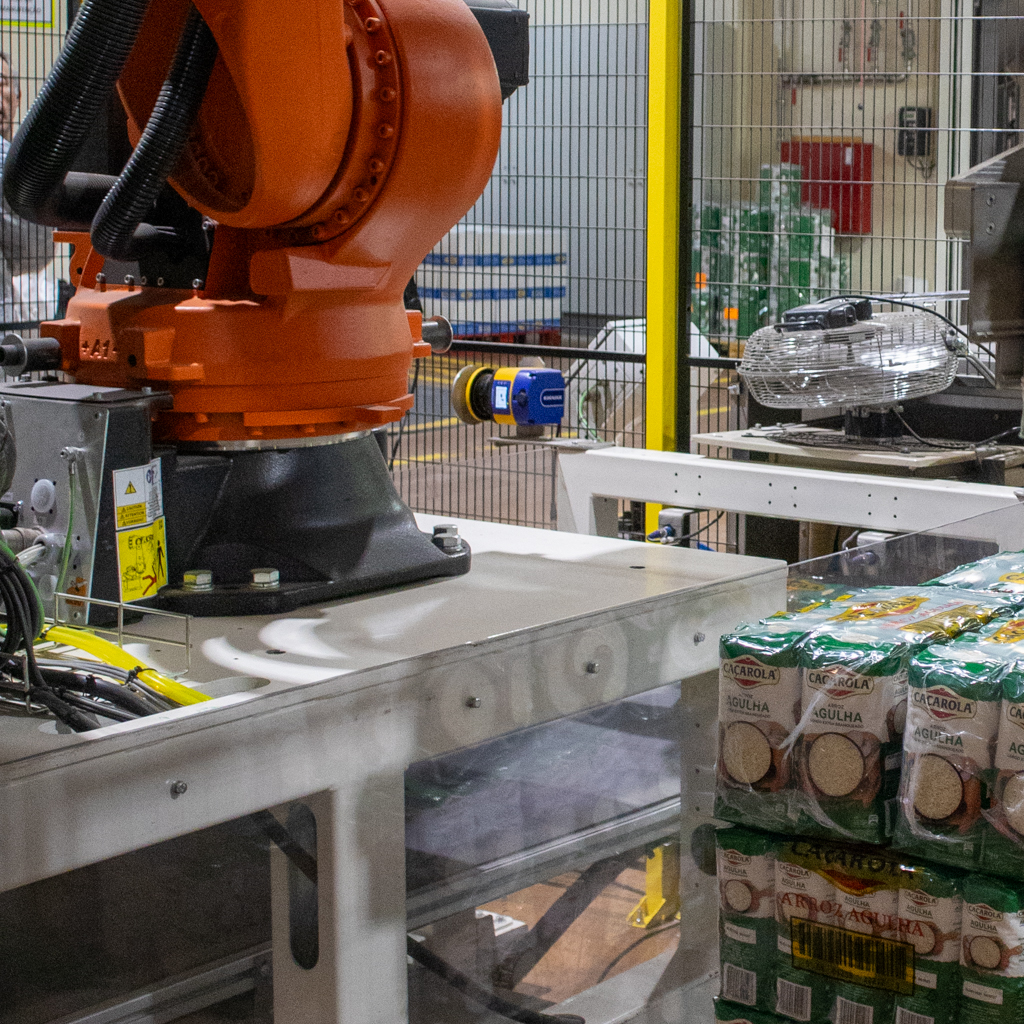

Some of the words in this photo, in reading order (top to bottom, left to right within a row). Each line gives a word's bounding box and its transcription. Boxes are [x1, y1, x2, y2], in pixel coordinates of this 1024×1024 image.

[726, 694, 771, 714] AGULHA
[812, 706, 863, 724] AGULHA
[914, 727, 964, 748] AGULHA
[780, 891, 843, 918] ARROZ
[850, 907, 925, 938] AGULHA
